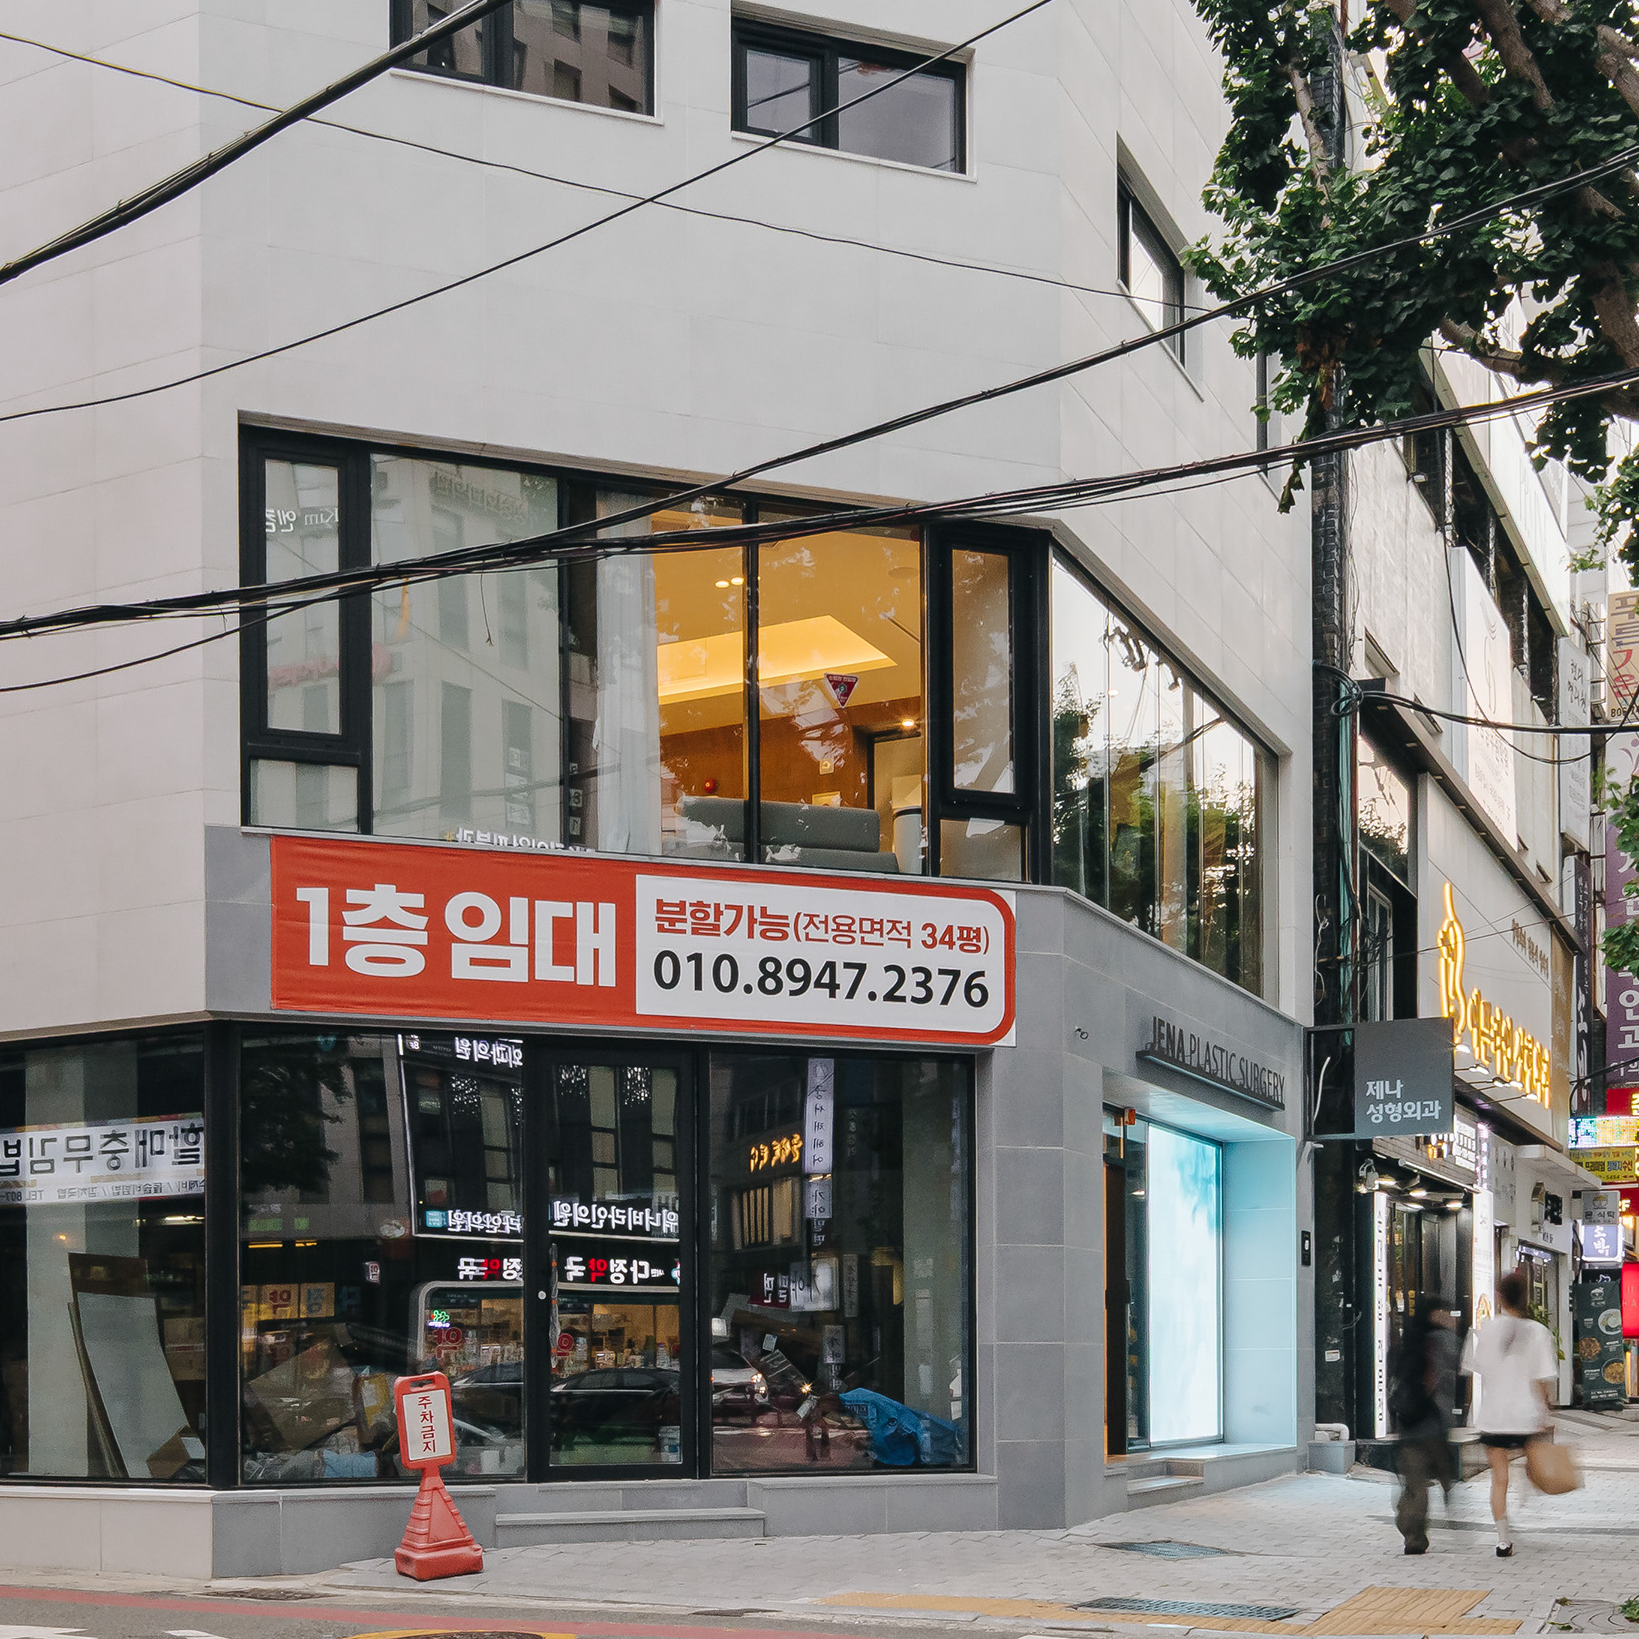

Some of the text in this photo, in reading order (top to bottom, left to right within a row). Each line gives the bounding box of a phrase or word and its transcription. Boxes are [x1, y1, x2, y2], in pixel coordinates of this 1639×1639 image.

[294, 884, 618, 989] 1층 임대
[652, 948, 991, 1010] 010.8947.2376
[1145, 1015, 1286, 1106] JENA PLASTIC SURGERY
[1365, 1078, 1404, 1100] 제나
[1365, 1099, 1442, 1124] 성형외과
[417, 1395, 437, 1454] 주차금지
